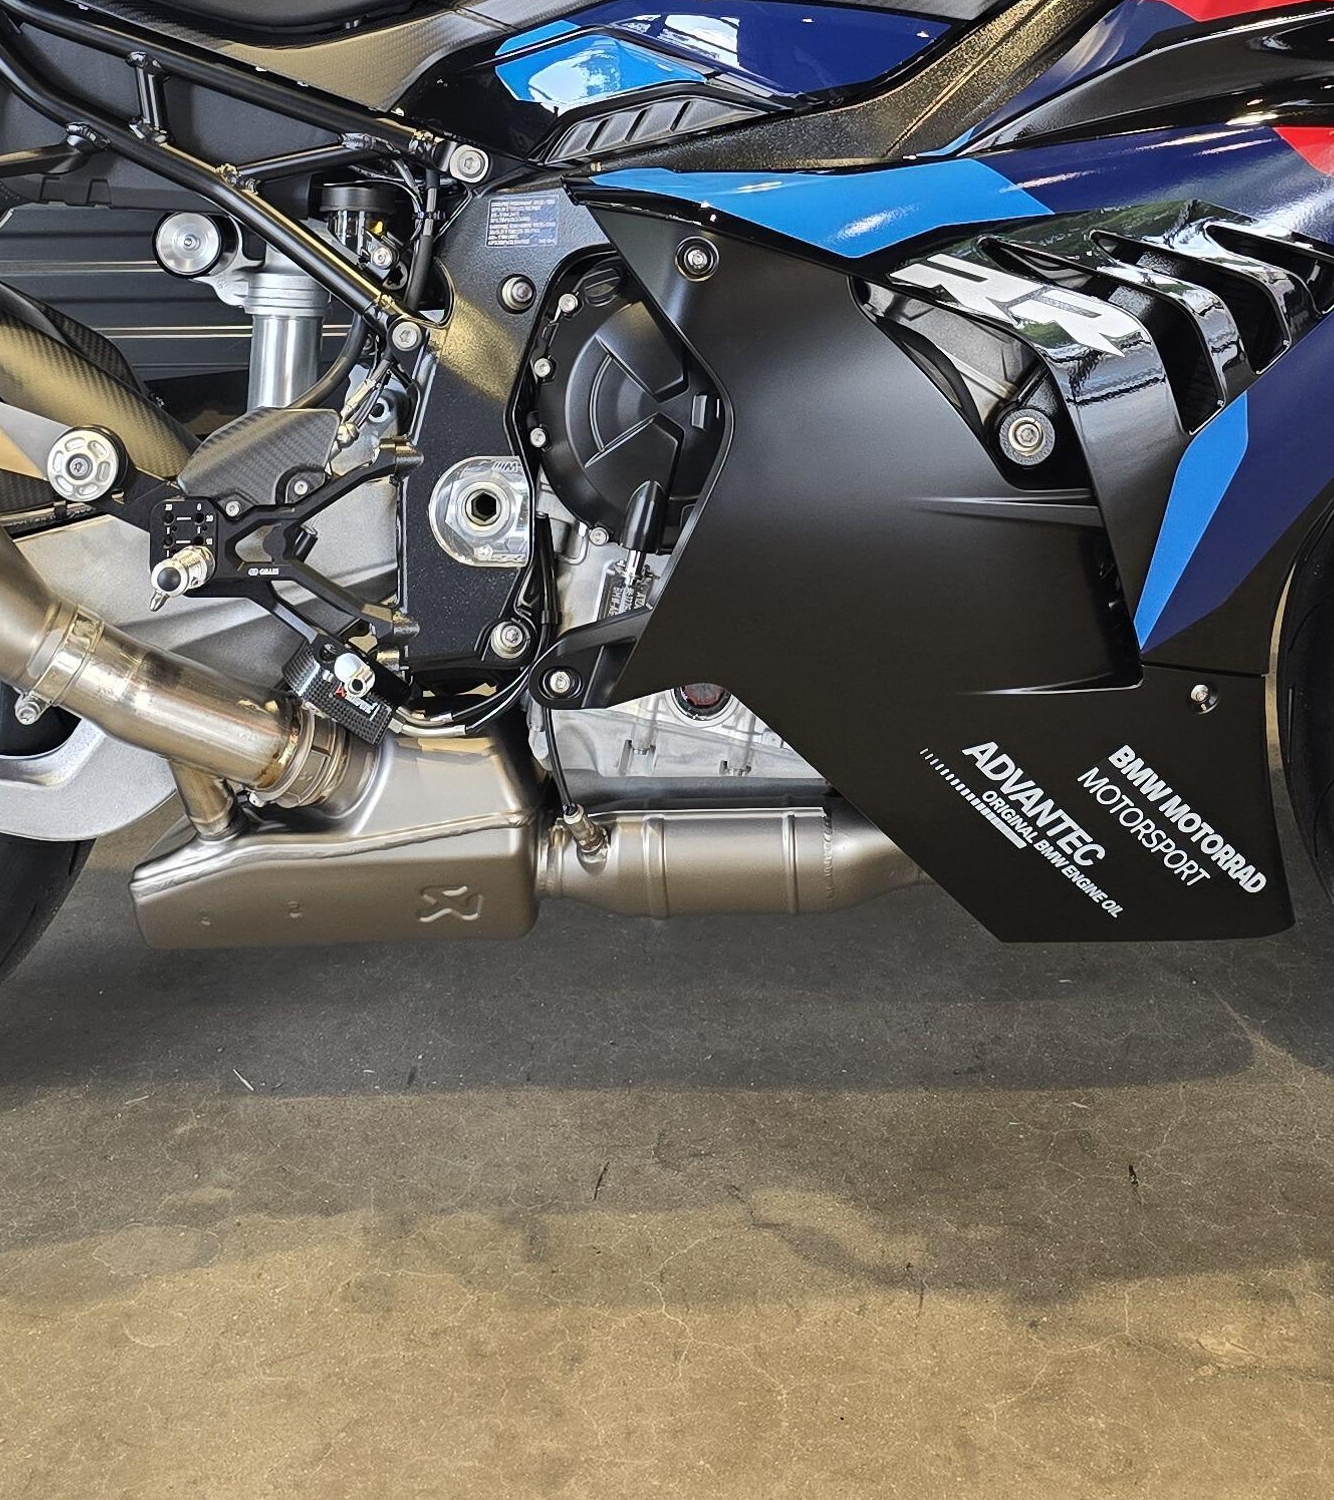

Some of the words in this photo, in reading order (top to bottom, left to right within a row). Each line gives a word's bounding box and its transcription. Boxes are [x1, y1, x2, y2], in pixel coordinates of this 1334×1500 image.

[962, 742, 1105, 866] ADVANTEC
[982, 790, 1038, 843] ORIGINAL
[1034, 839, 1069, 868] BMW
[1061, 865, 1108, 903] ENGINE
[1101, 899, 1123, 918] OIL
[1077, 767, 1210, 886] MOTORSPORT
[1108, 745, 1172, 801] BMW
[1158, 795, 1266, 893] MOTORRAD
